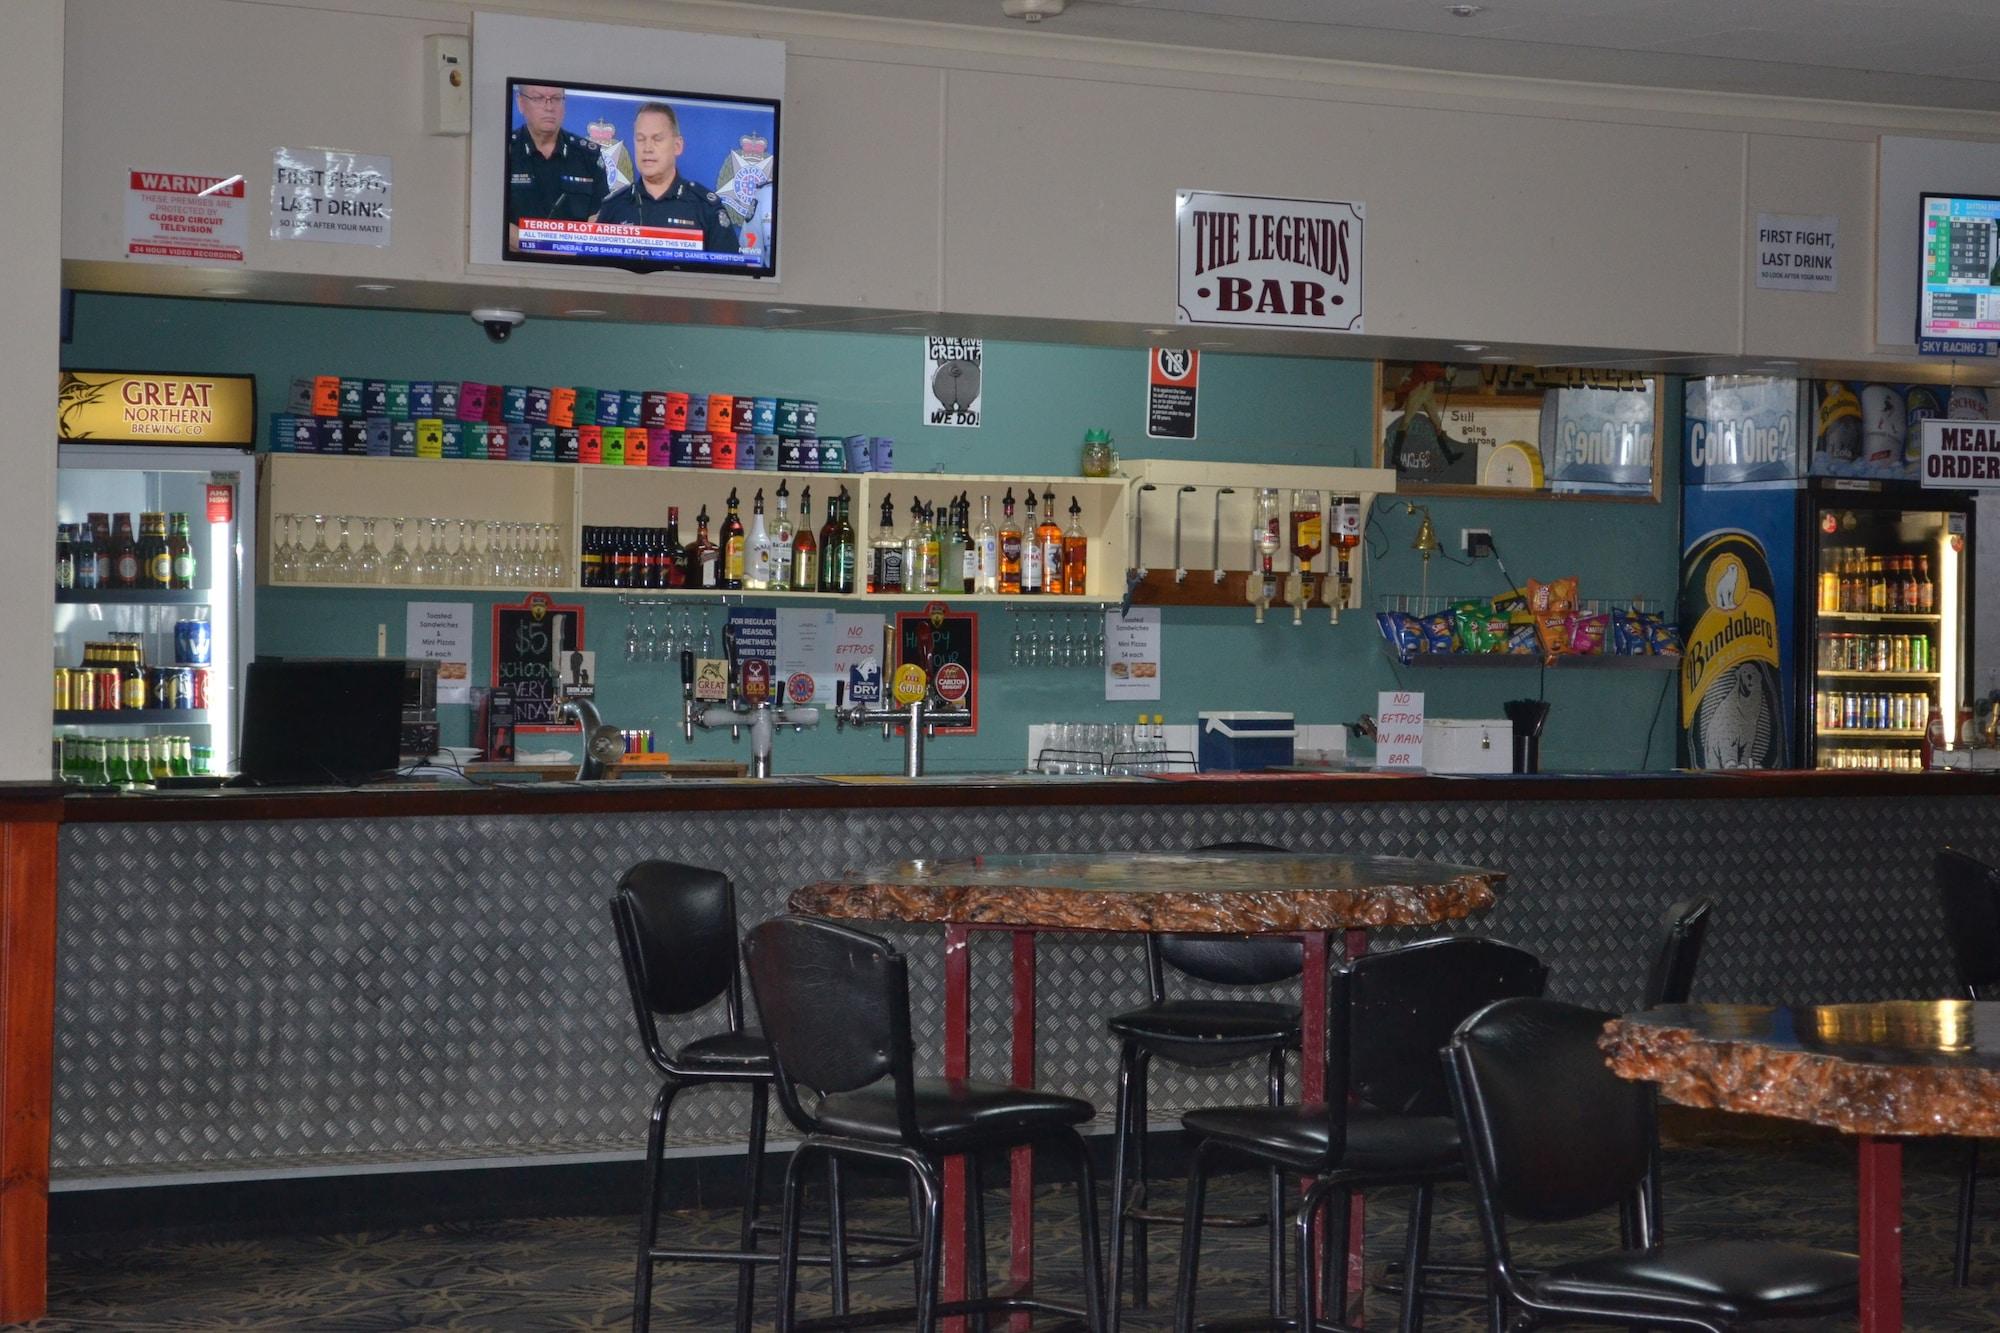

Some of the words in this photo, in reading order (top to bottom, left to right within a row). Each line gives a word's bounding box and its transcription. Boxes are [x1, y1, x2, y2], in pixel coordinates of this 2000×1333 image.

[142, 194, 169, 203] THESE
[172, 196, 214, 206] PREMISES
[216, 200, 232, 208] ARE
[156, 205, 204, 215] PROTECTED
[207, 208, 218, 216] BY
[328, 200, 384, 218] DRINK
[149, 213, 185, 222] CLOSED
[188, 216, 224, 225] CIRCUIT
[160, 223, 214, 234] TELEVISION
[314, 222, 336, 230] AFTER
[336, 223, 358, 232] YOUR
[360, 225, 383, 233] MATE!
[524, 220, 564, 231] TERROR
[568, 223, 594, 232] PLOT
[596, 224, 640, 236] ARRESTS
[537, 232, 558, 240] THREE
[574, 234, 588, 242] HAD
[588, 236, 626, 244] PASSPORTS
[626, 238, 664, 248] CANCELLED
[665, 240, 679, 248] THIS
[1760, 228, 1792, 245] FIRST
[1796, 232, 1835, 249] FIGHT,
[146, 247, 168, 255] HOUR
[169, 248, 192, 257] VIDEO
[194, 250, 241, 260] RECORDING
[552, 244, 583, 252] FUNERAL
[600, 246, 622, 254] SHARK
[624, 248, 649, 256] ATTACK
[1193, 211, 1240, 277] THE
[1248, 214, 1350, 285] LEGENDS
[1762, 252, 1792, 267] LAST
[1794, 254, 1832, 269] DRINK
[1815, 274, 1832, 282] MATE!
[1216, 276, 1326, 316] BAR
[931, 336, 944, 344] DO
[946, 336, 960, 346] WE
[931, 345, 982, 360] CREDIT?
[1922, 342, 1942, 352] SKY
[1943, 342, 1977, 353] RACING
[1978, 343, 1985, 354] 2
[1166, 354, 1184, 373] 18
[122, 381, 213, 407] GREAT
[124, 408, 212, 424] NORTHERN
[931, 412, 952, 424] WE
[957, 412, 980, 426] DO!
[1451, 411, 1474, 422] Still
[131, 424, 181, 435] BREWING
[1462, 425, 1487, 436] going
[1468, 437, 1497, 448] strong
[1691, 420, 1737, 467] Cold
[1743, 414, 1792, 464] One?
[1941, 428, 2000, 452] MEAL
[426, 612, 452, 620] Toasted
[419, 620, 458, 629] Sandwiches
[516, 619, 548, 656] $5
[848, 626, 863, 637] NO
[436, 650, 452, 658] each
[739, 646, 756, 656] NEED
[756, 648, 766, 656] TO
[1686, 611, 1773, 693] Bundaberg
[698, 680, 725, 690] GREAT
[854, 686, 878, 694] DRY
[900, 683, 924, 694] GOLD
[1394, 694, 1410, 704] NO
[1380, 712, 1422, 724] EFTPOS
[1377, 734, 1390, 744] IN
[1394, 734, 1422, 745] MAIN
[1388, 754, 1410, 764] BAR
